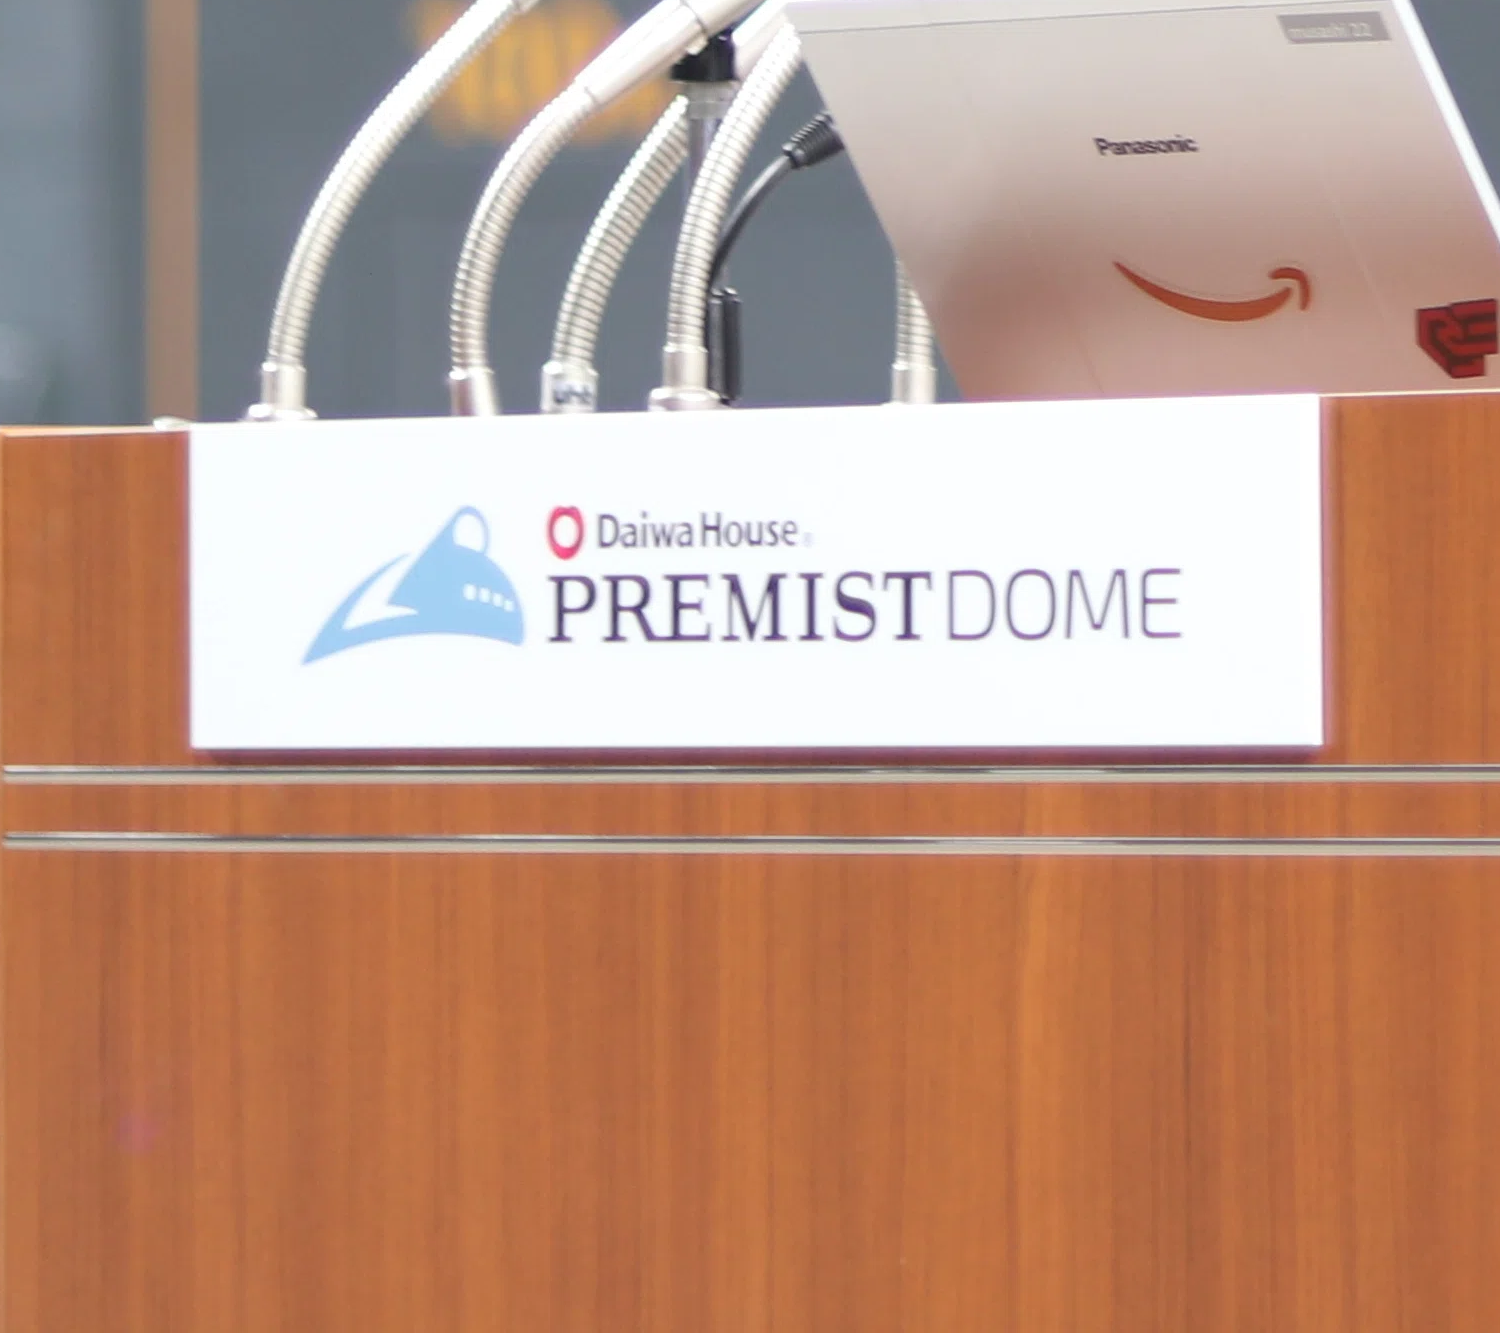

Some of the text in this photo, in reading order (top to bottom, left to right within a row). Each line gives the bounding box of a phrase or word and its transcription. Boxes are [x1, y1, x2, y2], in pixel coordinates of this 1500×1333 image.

[1092, 134, 1200, 157] Panasonic
[597, 510, 799, 549] Daiwa House
